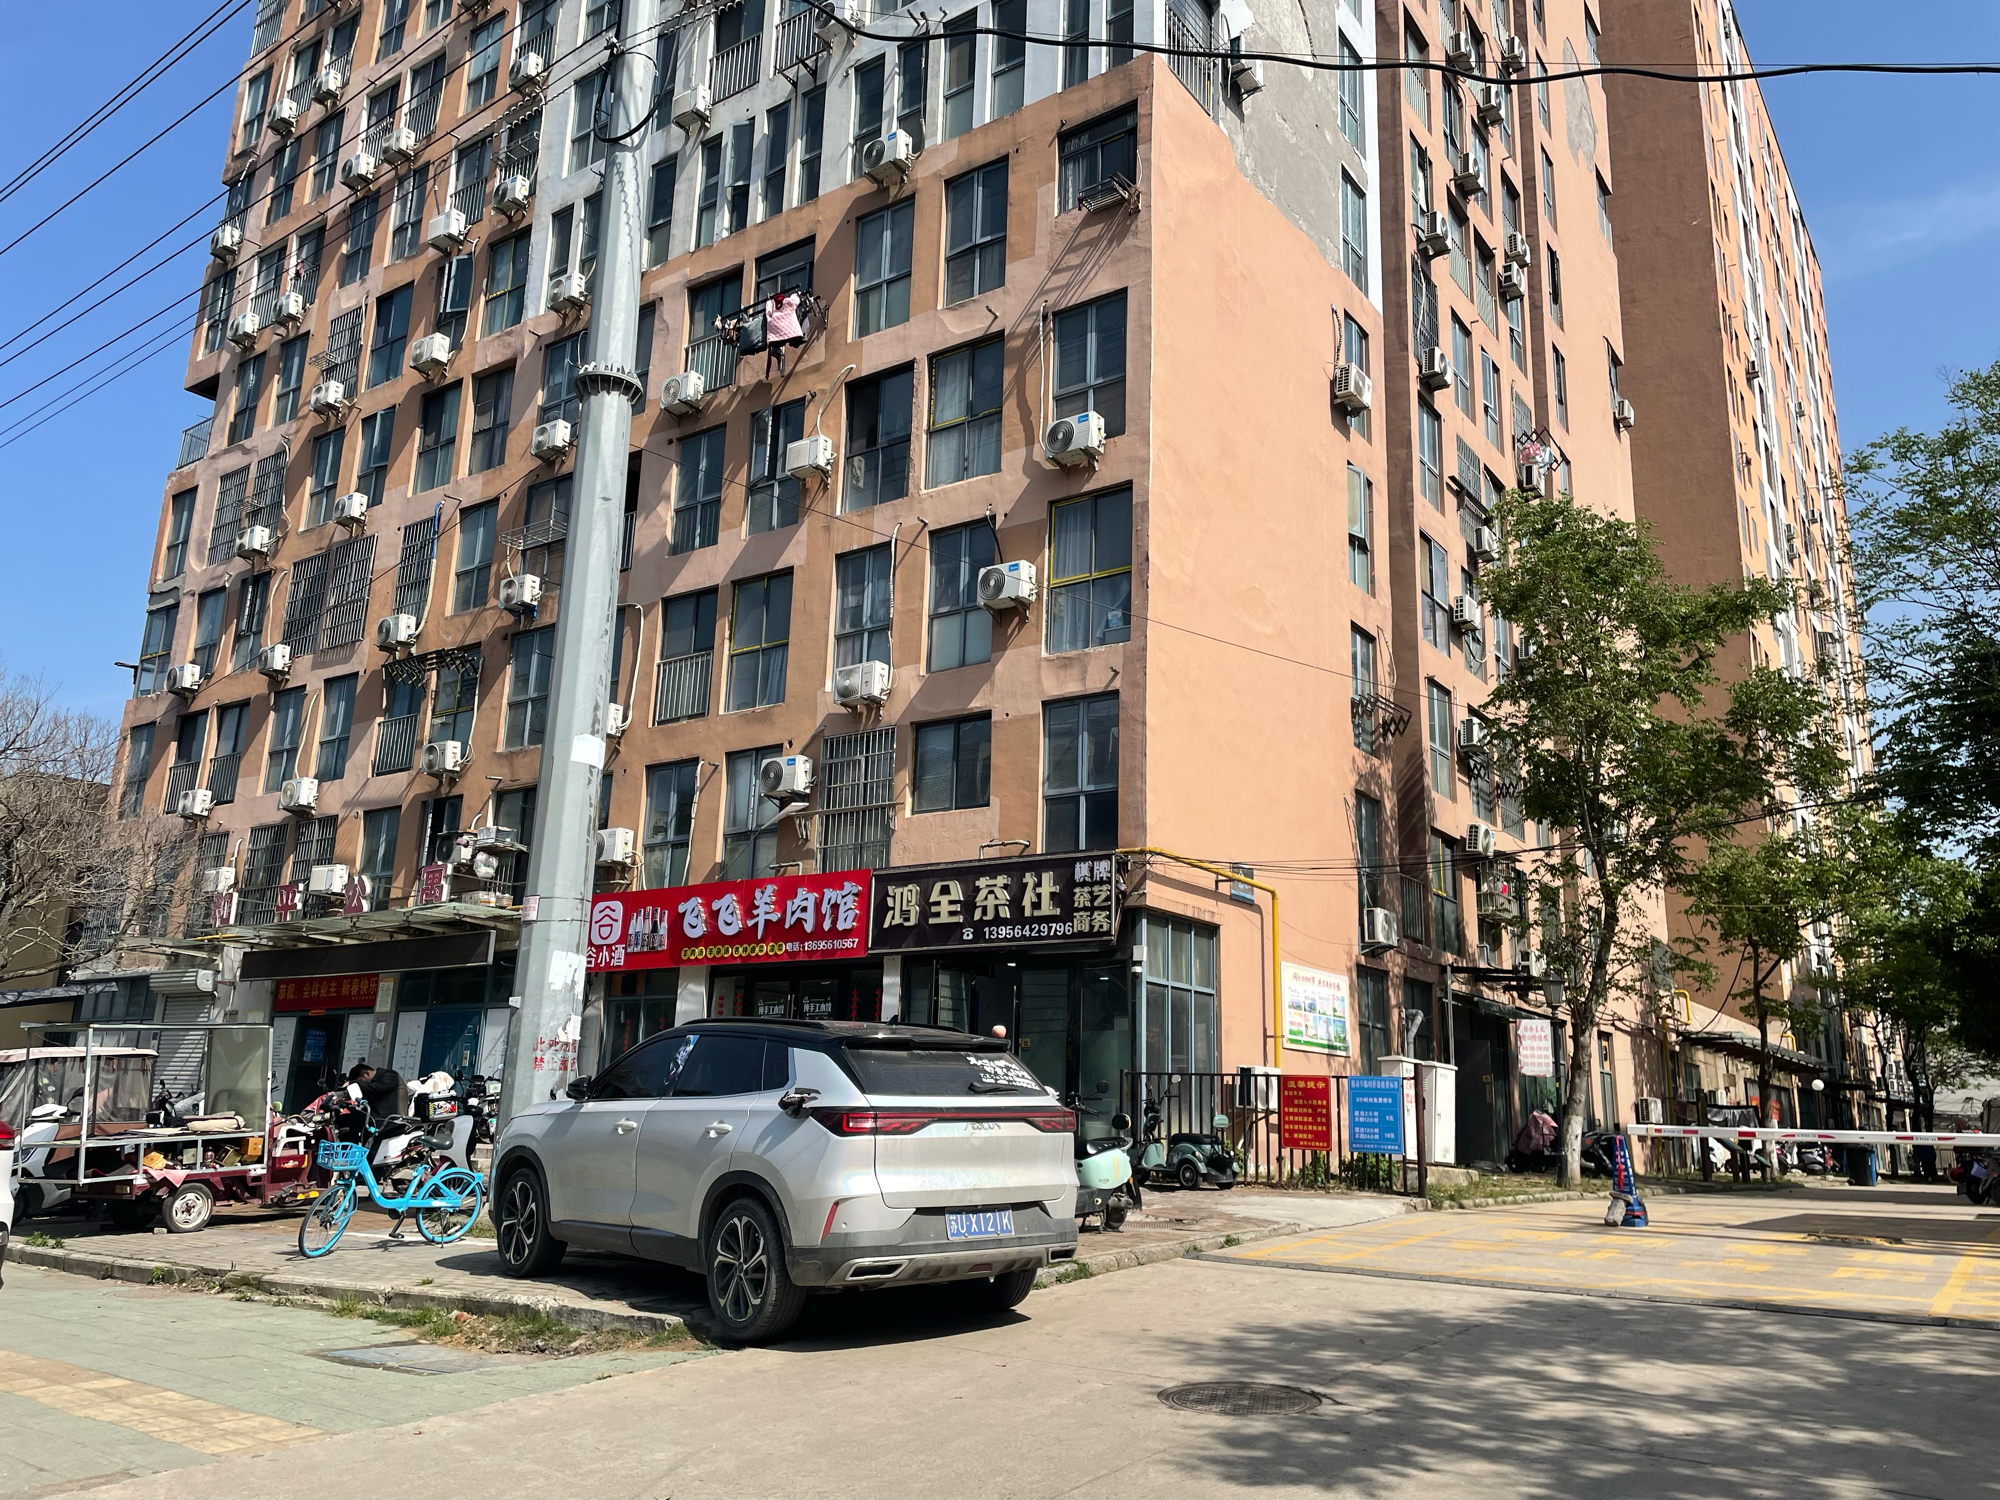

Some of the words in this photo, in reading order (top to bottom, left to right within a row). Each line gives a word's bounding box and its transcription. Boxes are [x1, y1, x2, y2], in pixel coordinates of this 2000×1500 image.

[1074, 860, 1110, 882] 棋牌
[883, 871, 1060, 928] 鸿全茶社
[1073, 884, 1111, 908] 茶艺
[678, 881, 862, 940] 飞飞羊肉馆
[1073, 909, 1111, 933] 商务
[983, 922, 1073, 939] 13956429796
[302, 980, 337, 998] 全体业主
[341, 976, 378, 996] 新春快乐
